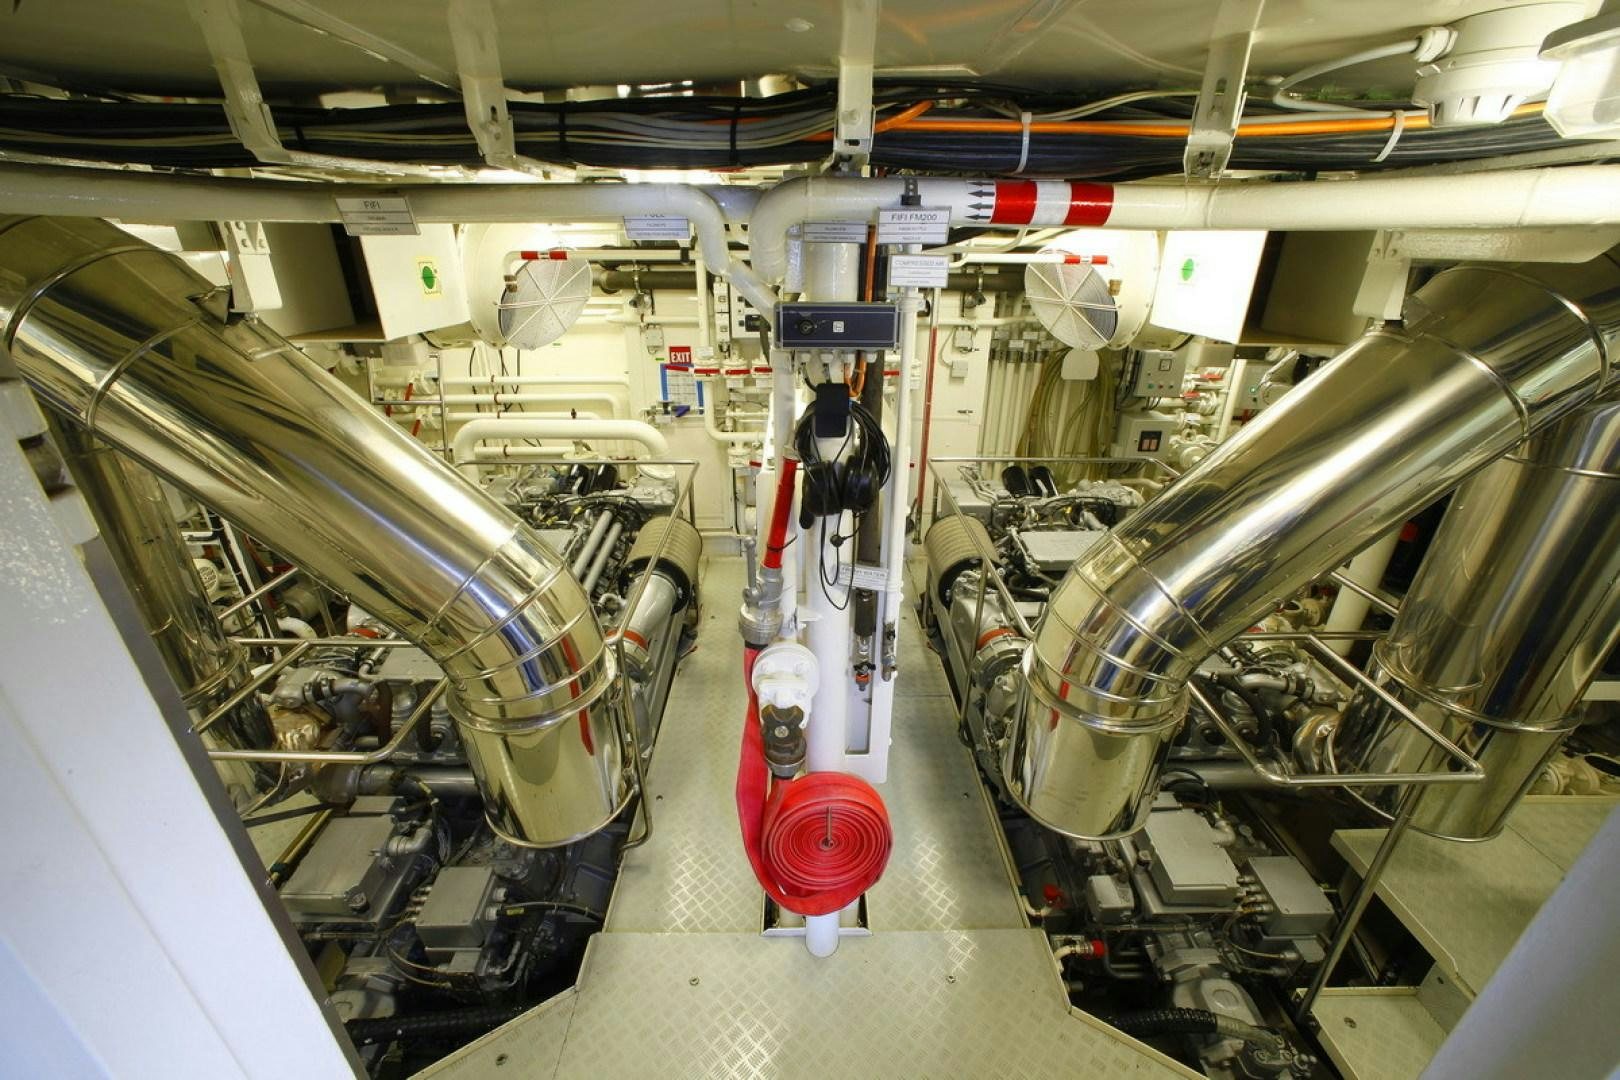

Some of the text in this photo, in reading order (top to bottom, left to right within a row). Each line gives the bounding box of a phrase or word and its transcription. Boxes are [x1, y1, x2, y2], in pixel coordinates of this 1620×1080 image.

[891, 213, 938, 221] FIFI FM200
[671, 351, 690, 363] EXIT
